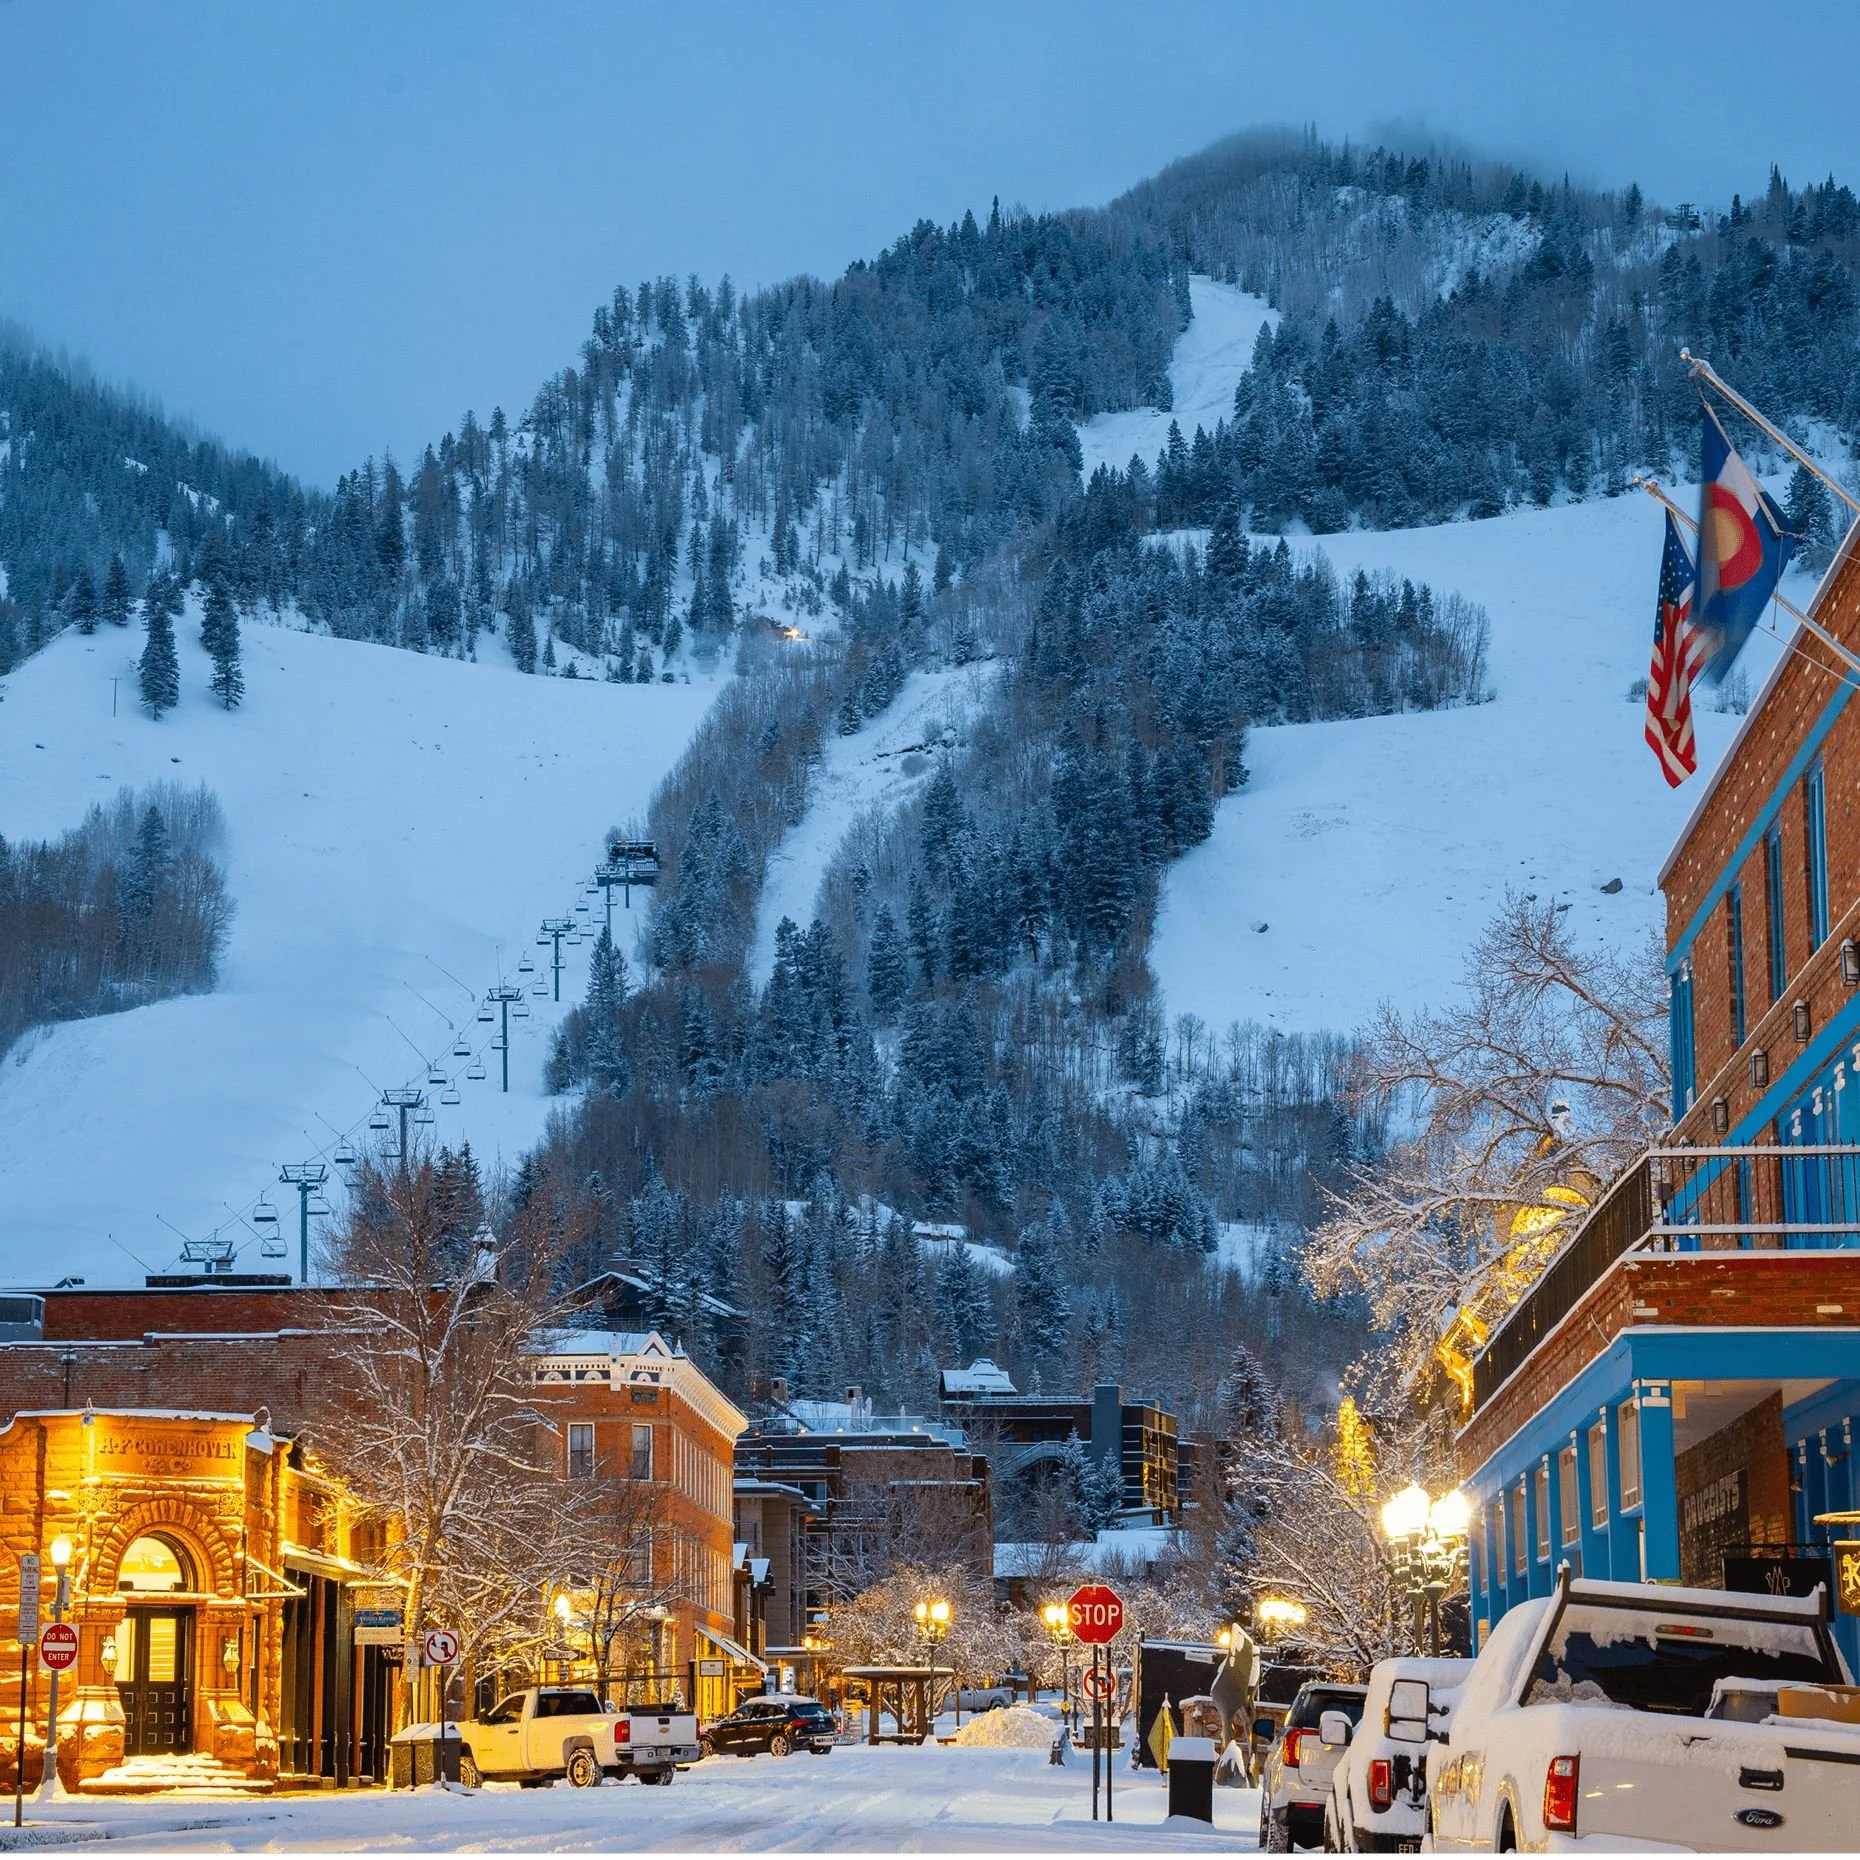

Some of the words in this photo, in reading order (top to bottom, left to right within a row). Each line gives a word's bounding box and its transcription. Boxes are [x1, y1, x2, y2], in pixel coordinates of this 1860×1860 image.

[1683, 1472, 1740, 1533] DRUGGISTS
[26, 1557, 35, 1566] NO
[1070, 1603, 1120, 1626] STOP
[46, 1632, 56, 1641] DO
[60, 1632, 73, 1641] NOT
[48, 1652, 70, 1661] ENTER
[1746, 1811, 1774, 1825] Ford
